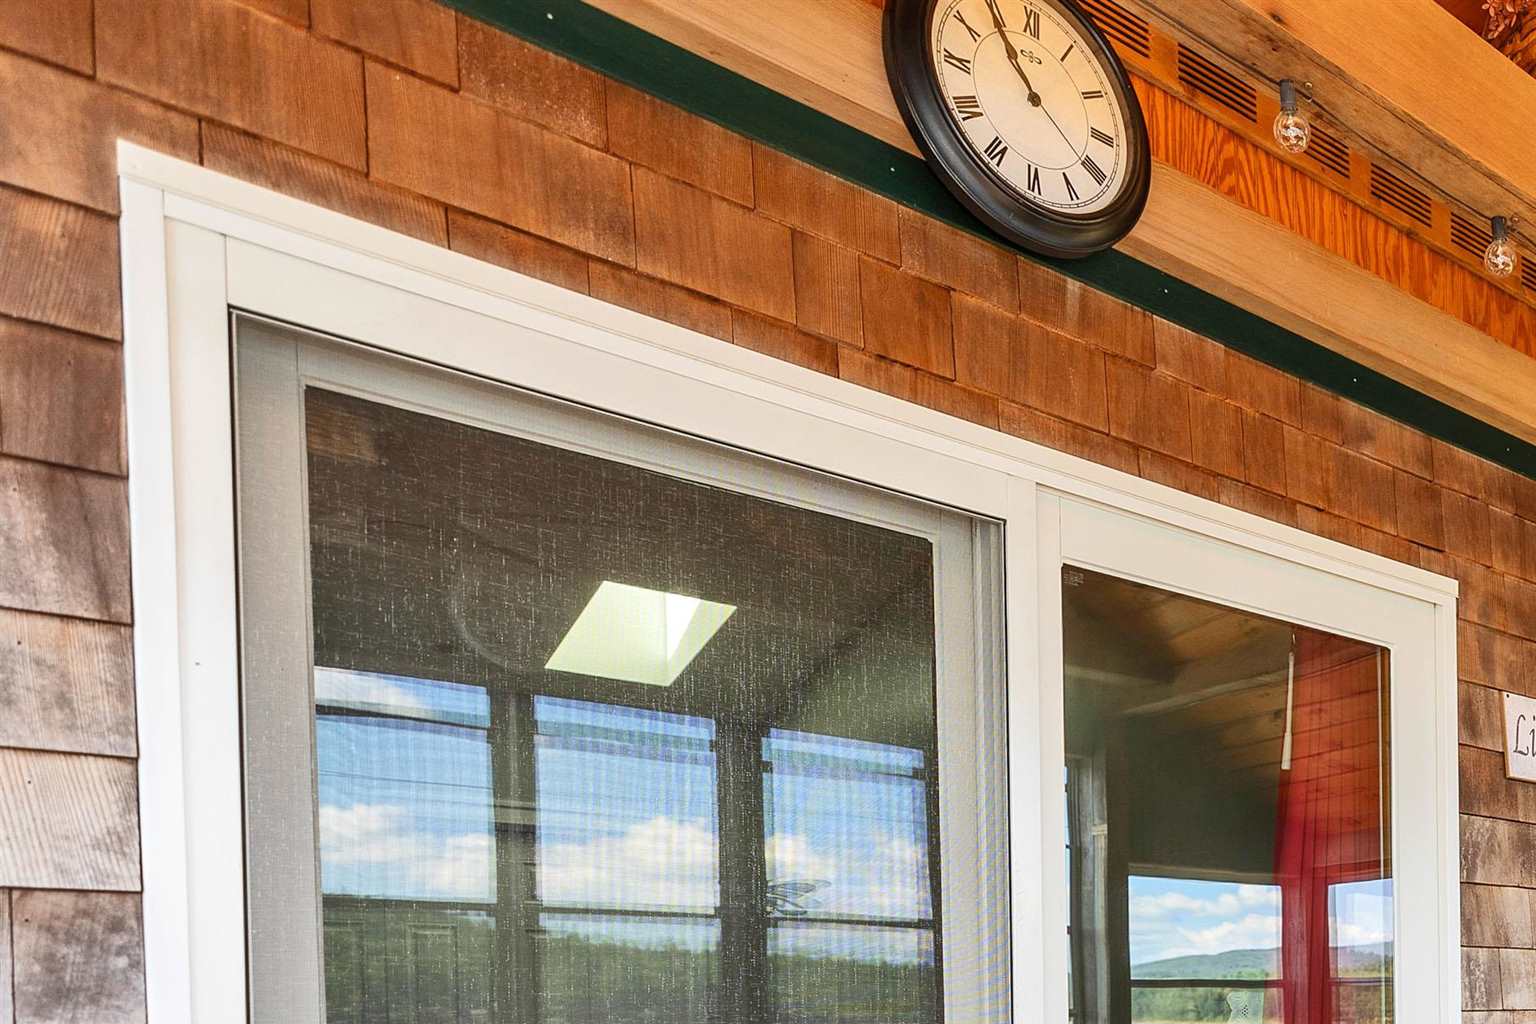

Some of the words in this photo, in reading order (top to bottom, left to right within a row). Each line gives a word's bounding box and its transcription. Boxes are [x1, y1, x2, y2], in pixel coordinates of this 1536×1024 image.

[953, 10, 981, 43] X
[1024, 6, 1040, 40] XII
[944, 48, 971, 75] IX
[1060, 43, 1075, 62] I
[952, 95, 983, 122] VIII
[1081, 90, 1104, 100] II
[1090, 127, 1114, 148] III
[984, 136, 1008, 168] VII
[1027, 164, 1042, 196] VI
[1062, 172, 1080, 201] V
